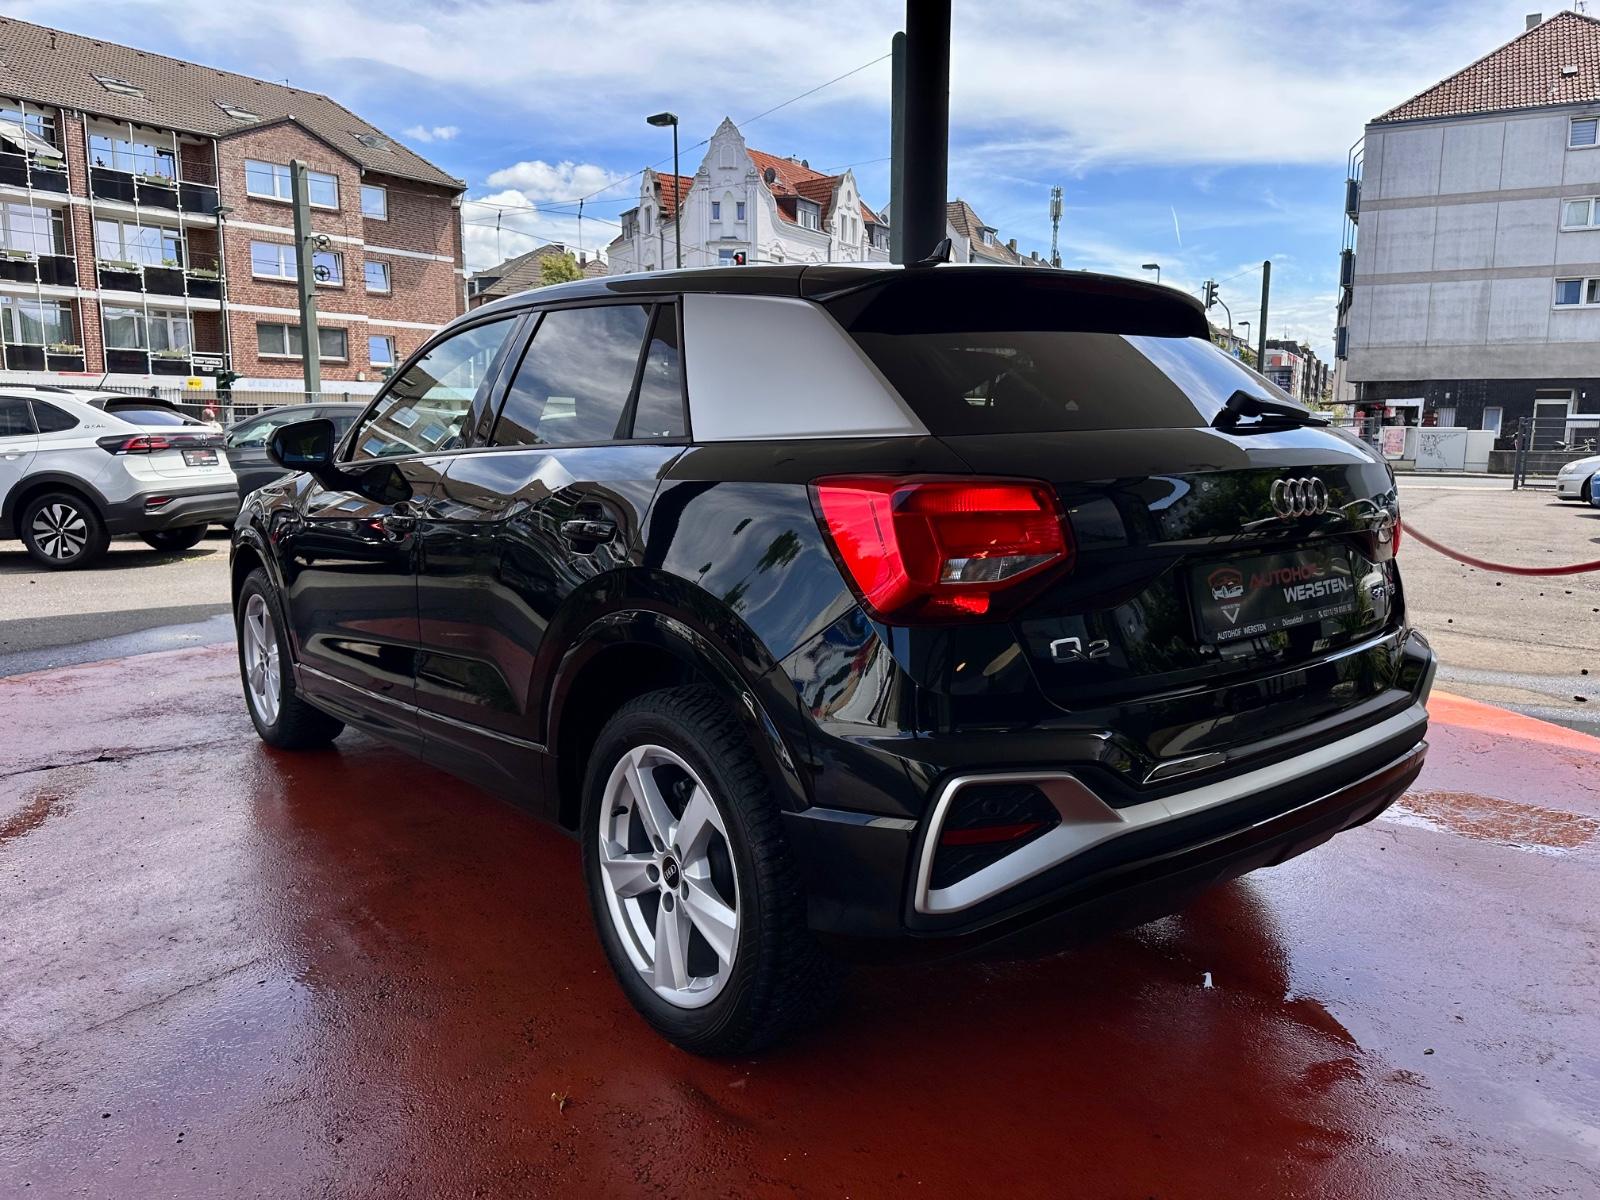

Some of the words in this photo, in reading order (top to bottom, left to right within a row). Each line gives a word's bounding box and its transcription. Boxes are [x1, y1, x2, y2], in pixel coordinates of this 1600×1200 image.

[1283, 577, 1347, 602] WERSTEN
[1217, 628, 1241, 641] AUTOHOF
[1243, 623, 1267, 634] WERSTEN
[1050, 636, 1110, 664] Q2
